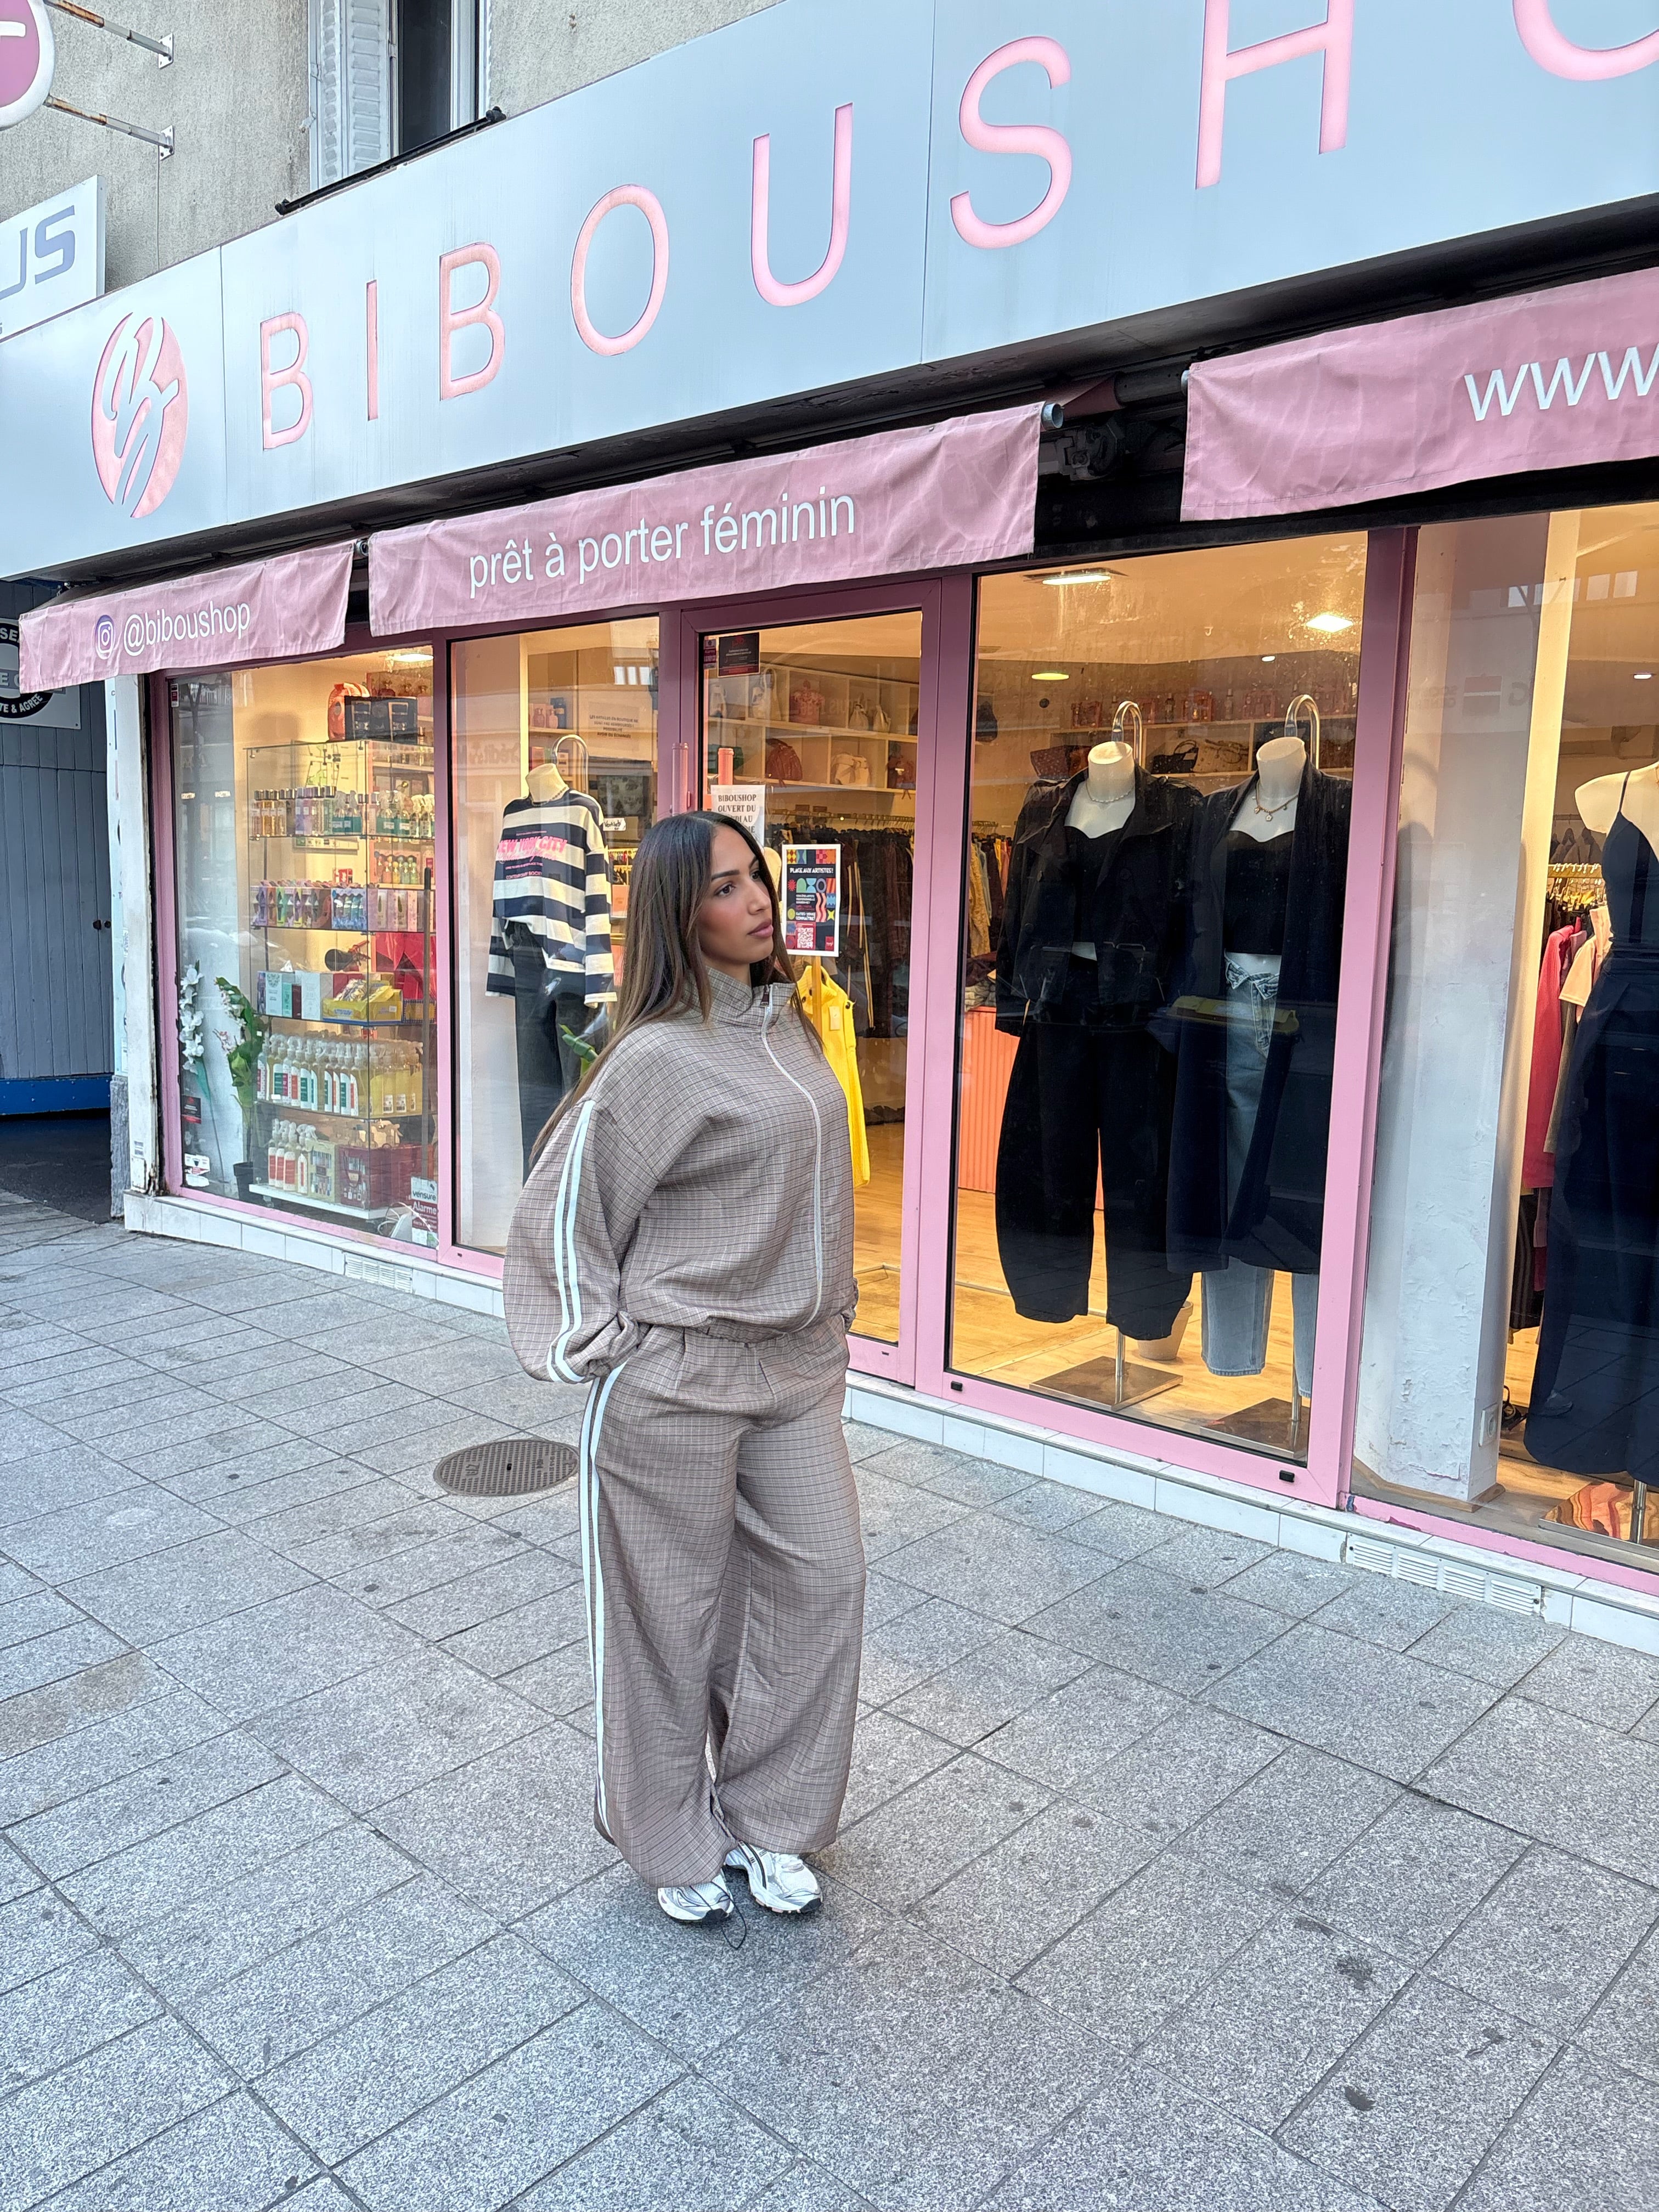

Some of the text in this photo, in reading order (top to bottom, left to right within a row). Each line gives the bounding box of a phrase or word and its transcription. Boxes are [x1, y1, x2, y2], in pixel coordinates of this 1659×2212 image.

[261, 0, 1659, 452] BIBOUSH
[470, 486, 855, 599] prêt à porter féminin
[123, 600, 250, 657] @biboushop
[538, 836, 568, 854] CITY
[413, 1201, 437, 1215] Alarme
